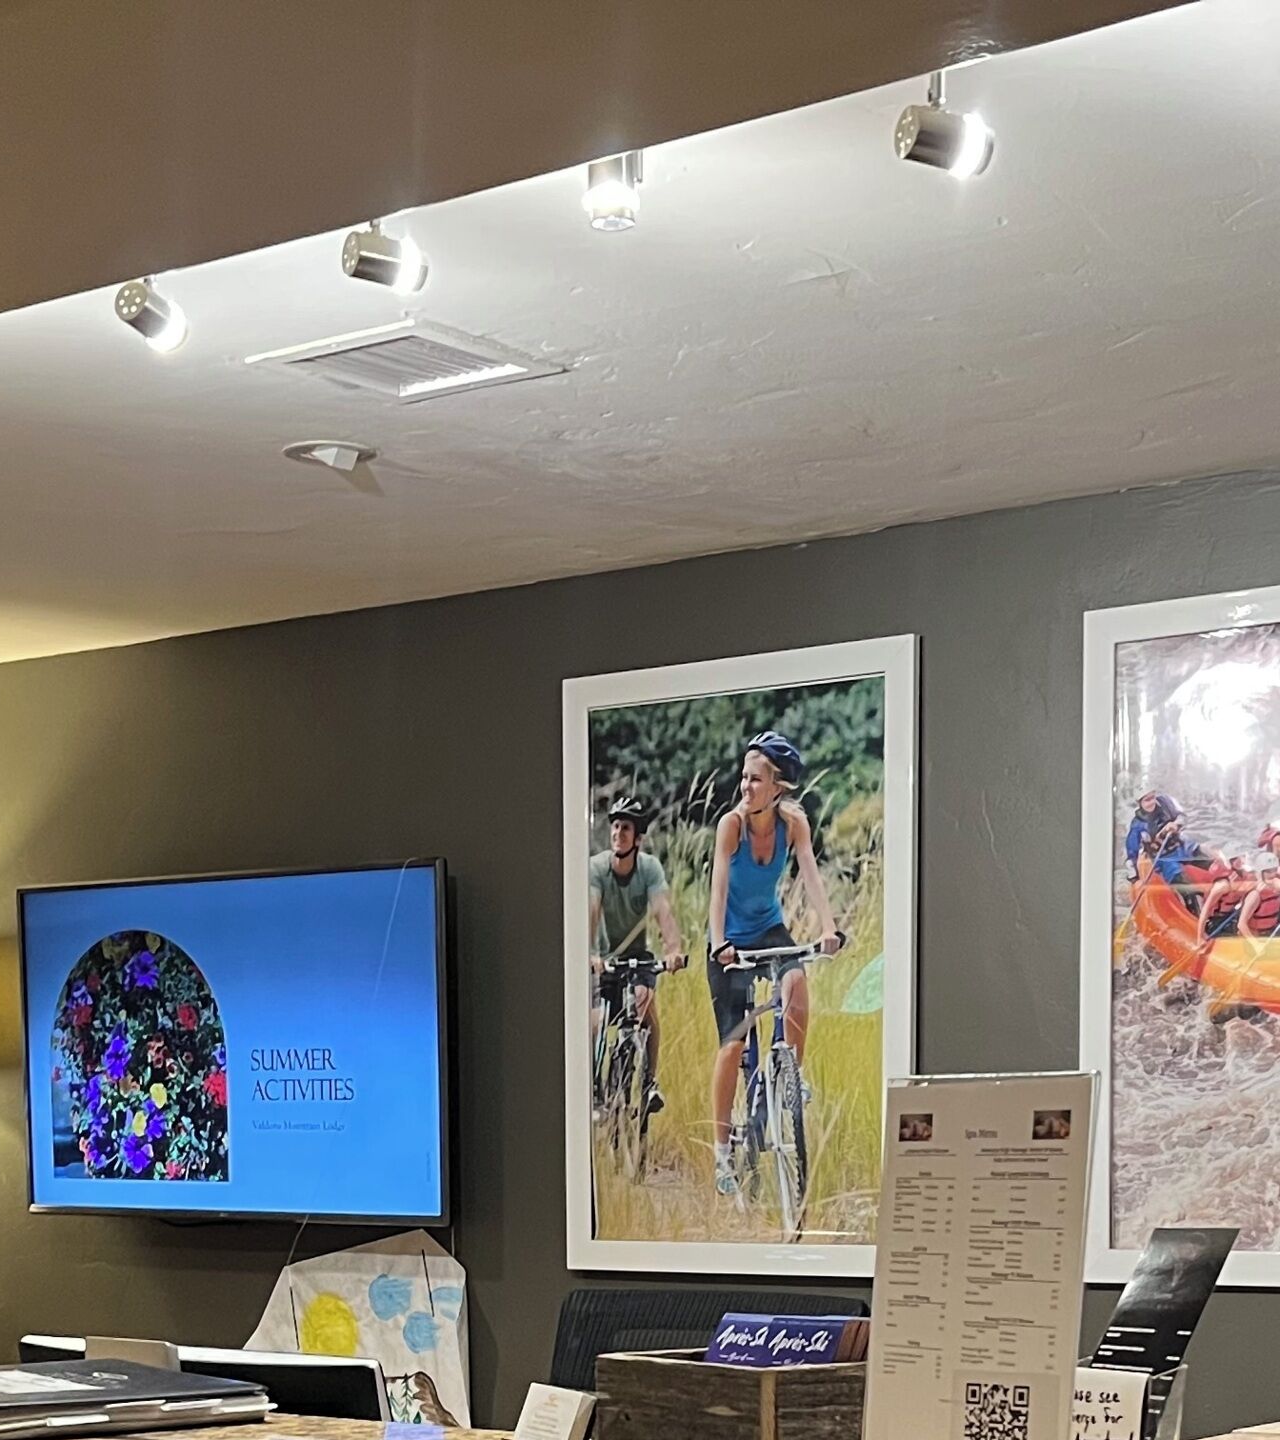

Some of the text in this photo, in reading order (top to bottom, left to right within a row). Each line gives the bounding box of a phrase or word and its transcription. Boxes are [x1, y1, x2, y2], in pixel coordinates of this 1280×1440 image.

[251, 1048, 336, 1072] SUMMER
[252, 1078, 355, 1101] ACTIVITIES
[1099, 1392, 1121, 1403] see
